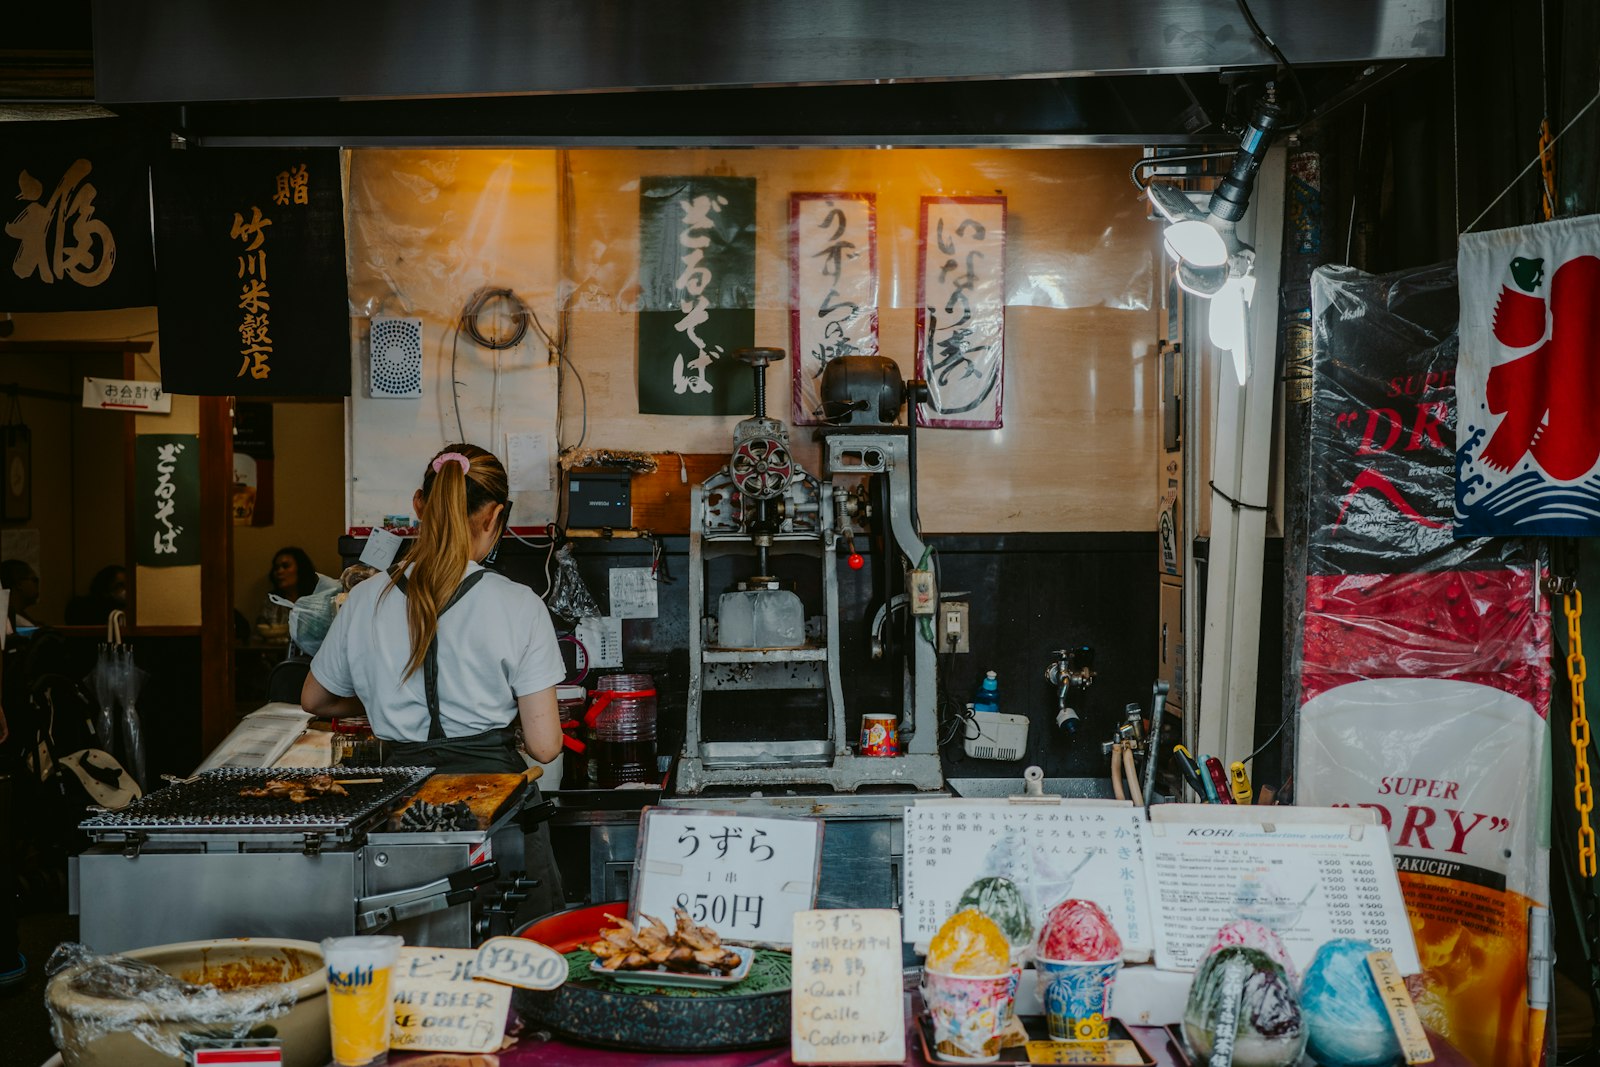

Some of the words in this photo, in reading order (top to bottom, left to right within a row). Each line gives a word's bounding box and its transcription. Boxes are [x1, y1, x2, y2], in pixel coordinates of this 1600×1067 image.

[272, 164, 310, 206] 贈
[5, 158, 116, 288] 福
[671, 194, 729, 396] ざるそば
[1340, 305, 1367, 321] Asahi
[105, 384, 149, 399] お会計
[1387, 370, 1455, 398] SUPE
[1336, 401, 1449, 456] “DR
[153, 443, 186, 555] ざるそば
[1378, 776, 1460, 800] SUPER
[941, 812, 952, 855] 宇治金時
[957, 812, 967, 831] 金時
[972, 812, 982, 832] 宇治
[989, 813, 998, 851] ミルク
[1034, 814, 1044, 853] ぶどう
[1049, 814, 1060, 854] めろん
[1064, 814, 1077, 854] れもん
[1080, 814, 1093, 854] いちご
[1095, 814, 1108, 854] みぞれ
[1187, 828, 1234, 837] KORI
[678, 825, 775, 862] うずら
[1114, 825, 1134, 881] かき氷
[1394, 856, 1461, 876] RAKUCHI"
[674, 893, 764, 929] 850円
[816, 914, 863, 932] うずら
[809, 981, 860, 997] Quail
[1375, 958, 1396, 993] Blue
[432, 991, 494, 1009] BEER
[810, 1006, 860, 1022] Caille
[809, 1029, 889, 1046] Codorniz
